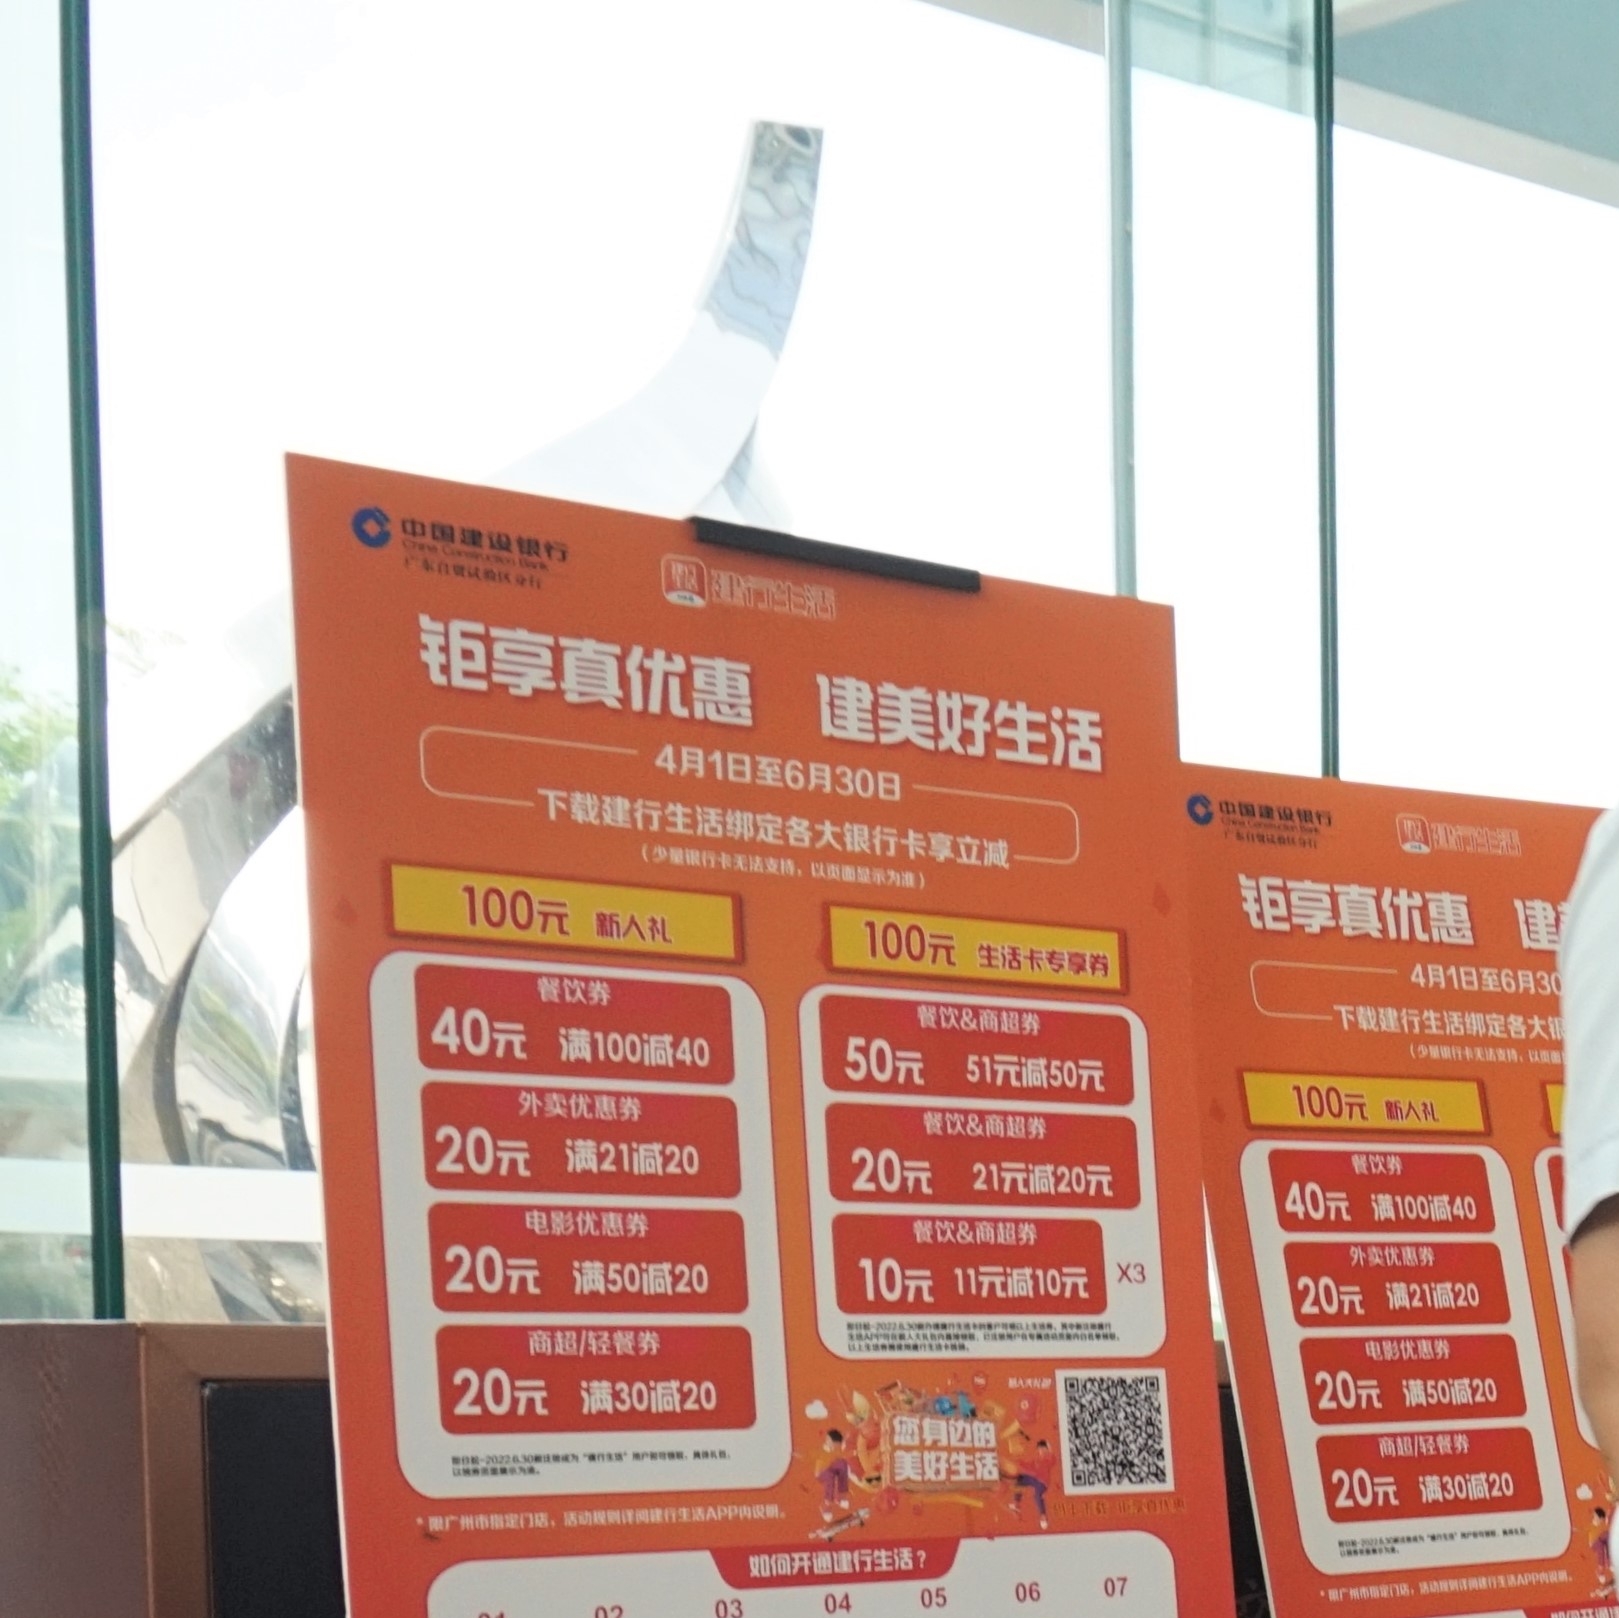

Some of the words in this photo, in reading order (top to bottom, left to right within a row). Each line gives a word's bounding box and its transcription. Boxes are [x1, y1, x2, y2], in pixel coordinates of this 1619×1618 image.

[402, 518, 569, 563] 中国建设银行
[418, 612, 755, 728] 钜享真优惠
[816, 673, 1103, 774] 建美好生活
[654, 743, 903, 803] 4月1日至6月30日
[535, 789, 1011, 871] 下载建行生活绑定各大银行卡享立减
[1219, 800, 1333, 828] 中国建设银行
[458, 884, 571, 939] 100元
[594, 910, 674, 946] 新人礼
[1238, 873, 1475, 946] 钜享真优惠
[862, 917, 958, 970] 100元
[977, 941, 1111, 980] 生活卡专享券
[535, 974, 613, 1006] 餐饮券
[429, 1007, 528, 1062] 40元
[557, 1027, 711, 1069] 满100减40
[915, 1002, 1042, 1036] 餐饮&商超券
[842, 1036, 926, 1086] 50元
[964, 1053, 1107, 1094] 51元减50元
[516, 1089, 644, 1122] 外卖优惠券
[1292, 1084, 1368, 1122] 100元
[1384, 1101, 1440, 1123] 新人礼
[920, 1109, 1048, 1142] 餐饮&商超券
[433, 1126, 532, 1180] 20元
[563, 1137, 701, 1178] 满21减20
[849, 1145, 934, 1197] 20元
[971, 1159, 1115, 1200] 21元减20元
[1351, 1154, 1404, 1176] 餐饮券
[1284, 1181, 1352, 1222] 40元
[1370, 1193, 1478, 1223] 满100减40
[524, 1210, 650, 1239] 电影优惠券
[912, 1220, 1038, 1247] 餐饮&商超券
[444, 1244, 541, 1297] 20元
[572, 1261, 709, 1296] 满50减20
[1350, 1246, 1436, 1268] 外卖优惠券
[858, 1257, 935, 1304] 10元
[953, 1265, 1090, 1300] 11元减10元
[1297, 1276, 1365, 1316] 20元
[1385, 1281, 1480, 1310] 满21减20
[528, 1329, 661, 1359] 商超/轻餐券
[1365, 1339, 1451, 1362] 电影优惠券
[452, 1366, 549, 1418] 20元
[579, 1379, 718, 1415] 满30减20
[1314, 1370, 1383, 1411] 20元
[1402, 1377, 1498, 1407] 满50减20
[893, 1415, 996, 1450] 您身边的
[1378, 1433, 1471, 1459] 商超/轻餐券
[894, 1450, 999, 1483] 美好生活
[1331, 1467, 1400, 1509] 20元
[1418, 1471, 1514, 1505] 满30减20
[823, 1592, 853, 1614] 04
[920, 1587, 948, 1609] 05
[1014, 1581, 1041, 1603] 06
[1103, 1576, 1129, 1598] 07
